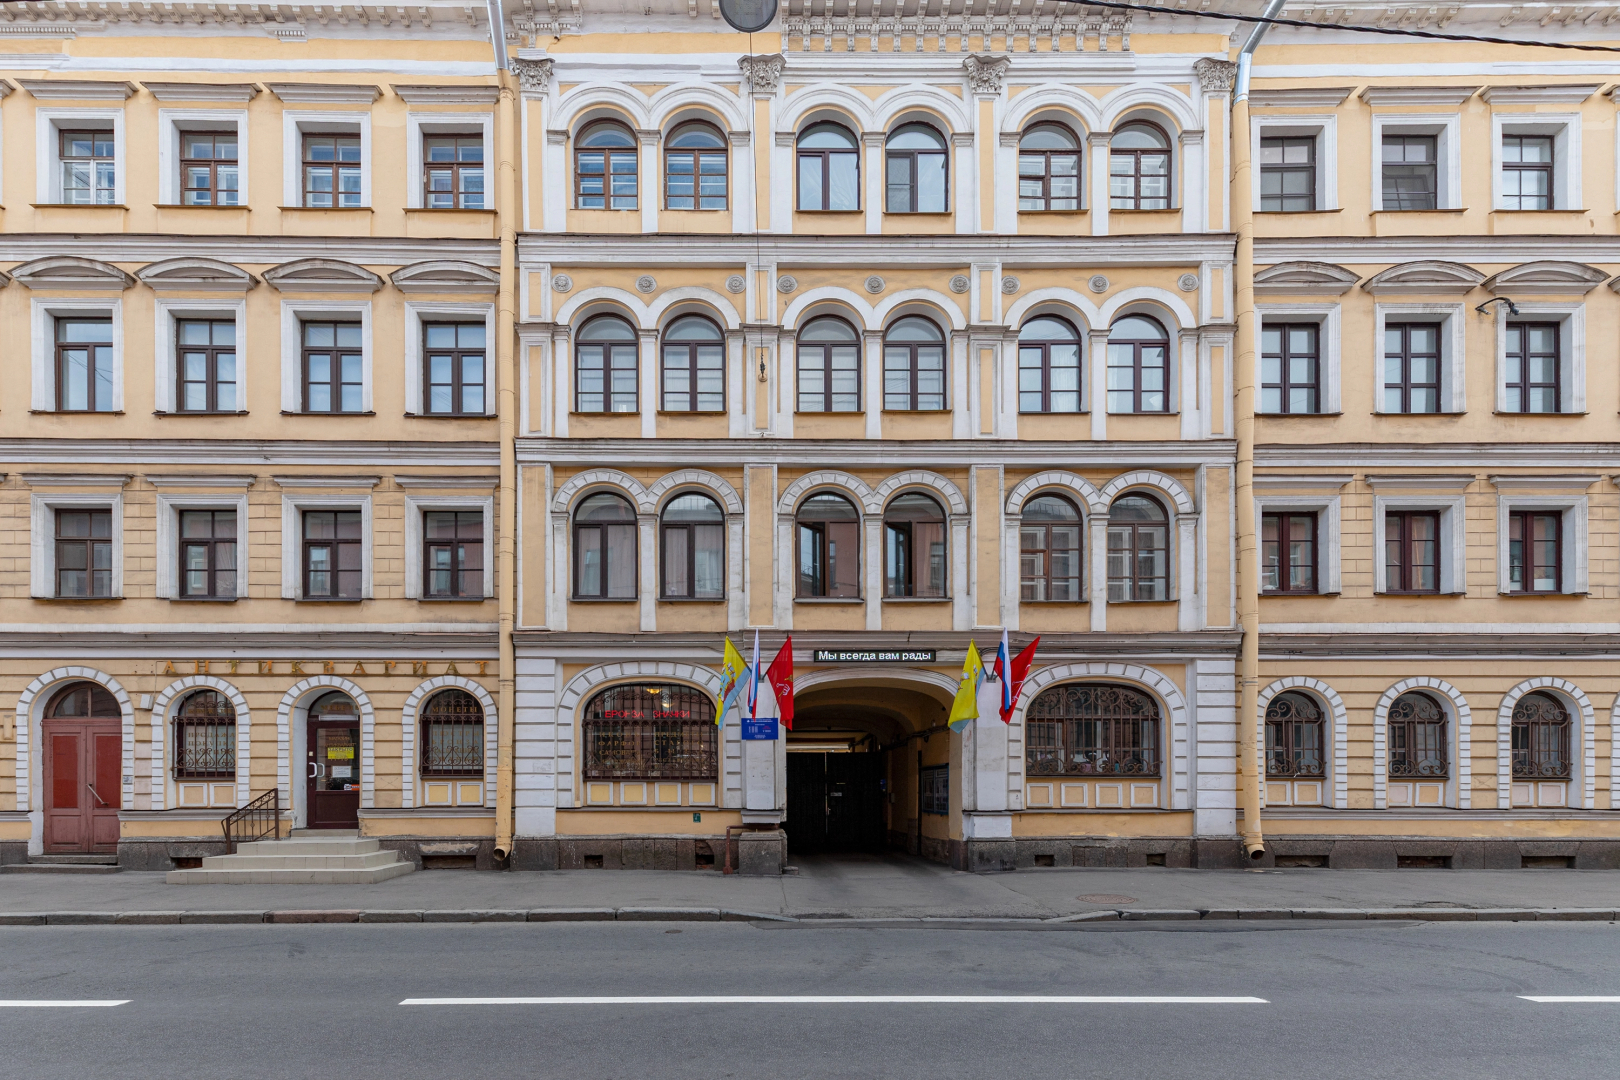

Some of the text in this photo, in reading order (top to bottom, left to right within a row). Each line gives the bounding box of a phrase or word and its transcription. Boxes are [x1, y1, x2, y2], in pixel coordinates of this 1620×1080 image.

[818, 651, 931, 661] Мы всегда вам рады
[162, 660, 489, 676] АНТИКВАРИАТ
[652, 710, 690, 719] ЗНАЧКИ
